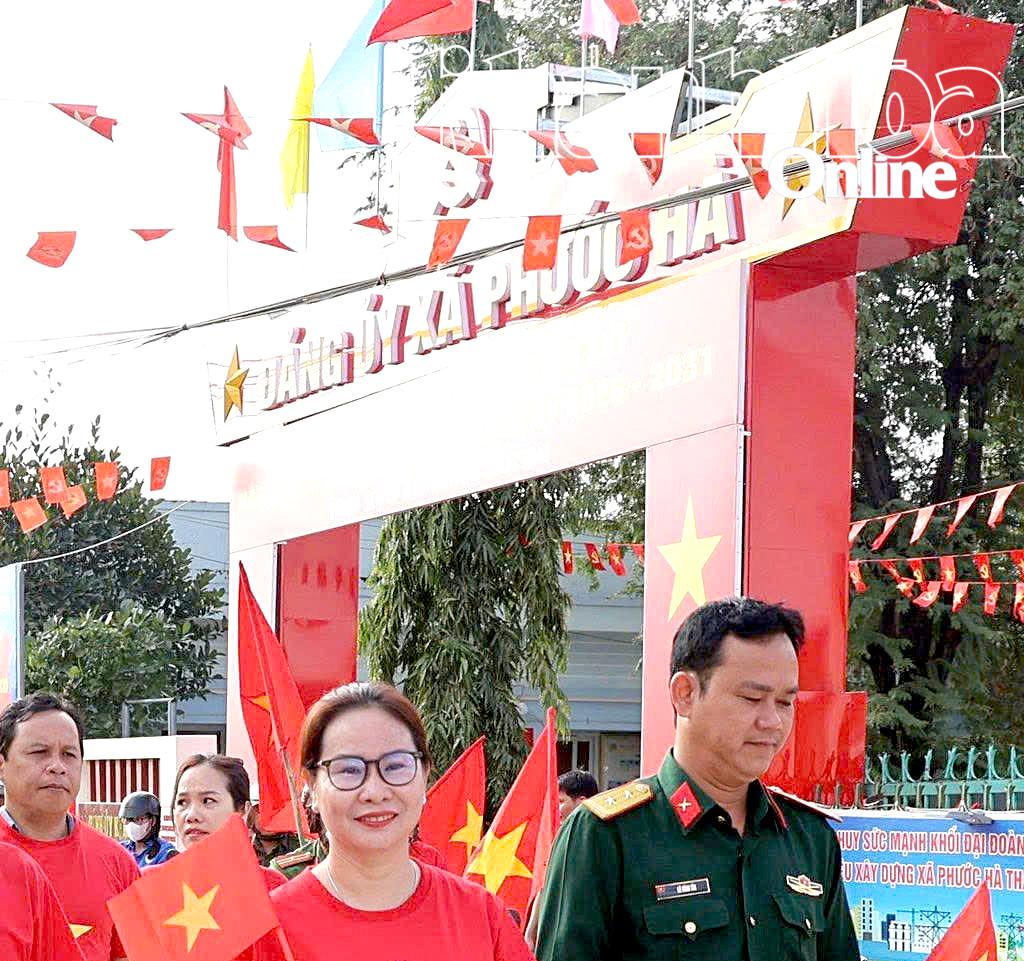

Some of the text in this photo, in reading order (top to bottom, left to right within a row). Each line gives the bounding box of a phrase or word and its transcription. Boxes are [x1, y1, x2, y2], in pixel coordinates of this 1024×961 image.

[260, 327, 354, 411] ĐẢNG
[412, 264, 478, 356] XÃ
[863, 827, 887, 851] SỨC
[890, 831, 927, 856] MẠNH
[930, 826, 960, 853] KHỐI
[964, 832, 986, 858] ĐẠI
[855, 859, 878, 883] XÂY
[880, 862, 914, 888] DỰNG
[917, 861, 934, 886] XÃ
[937, 862, 981, 887] PHƯỚC
[984, 864, 1003, 890] HÀ
[1006, 869, 1024, 891] TH
